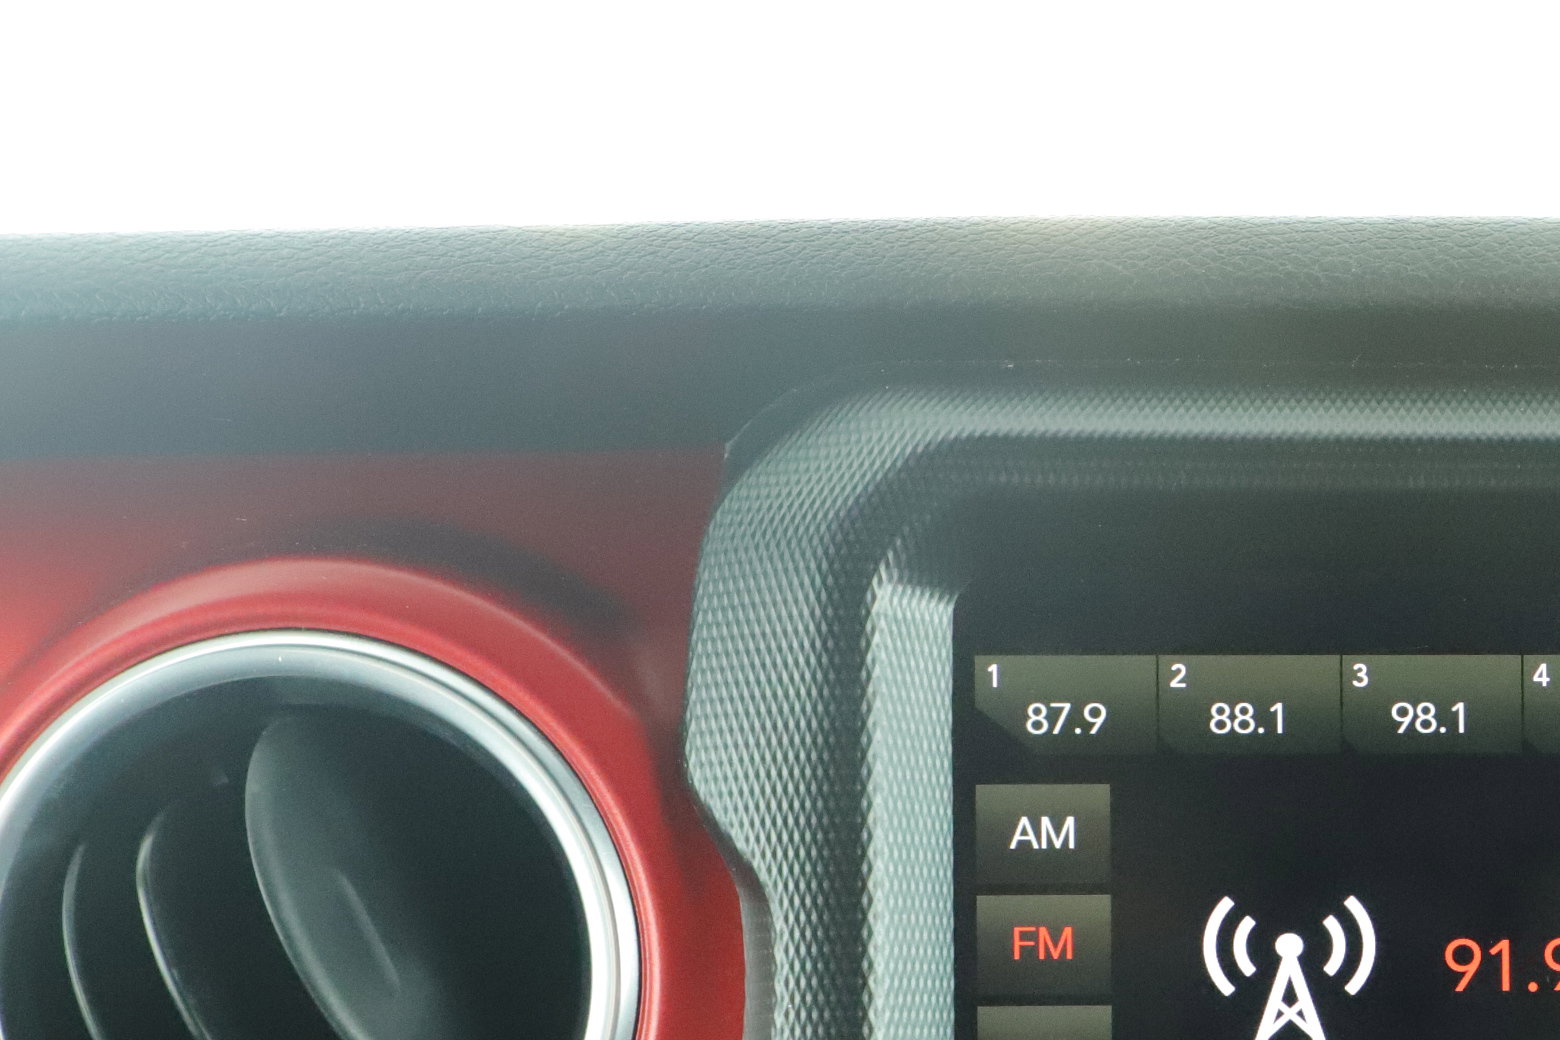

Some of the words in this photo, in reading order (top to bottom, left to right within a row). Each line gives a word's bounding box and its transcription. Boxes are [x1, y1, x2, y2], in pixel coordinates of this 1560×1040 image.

[986, 662, 999, 689] 1
[1168, 662, 1188, 689] 2
[1351, 662, 1370, 689] 3
[1531, 661, 1552, 688] 4
[1024, 702, 1108, 736] 87.9
[1208, 702, 1284, 735] 88.1
[1390, 701, 1466, 735] 98.1
[1008, 815, 1077, 850] AM
[1012, 926, 1075, 961] FM
